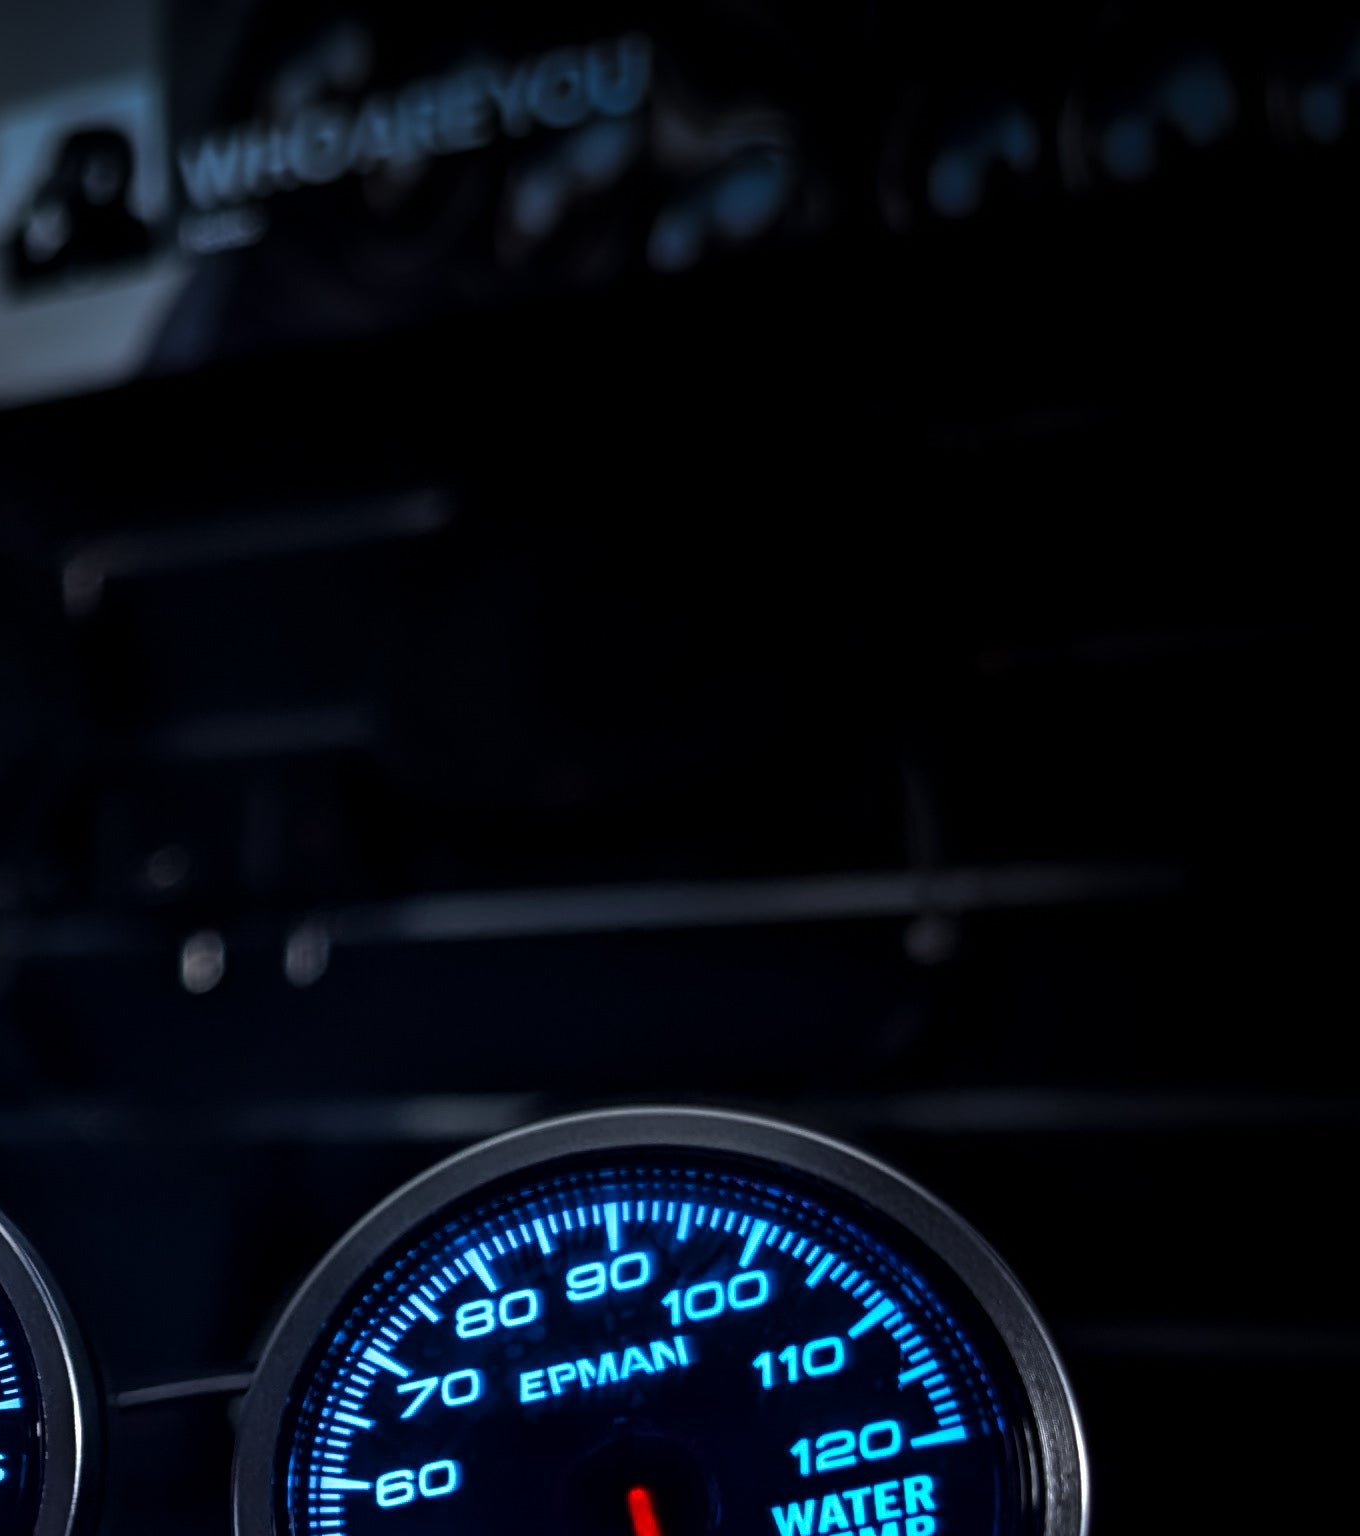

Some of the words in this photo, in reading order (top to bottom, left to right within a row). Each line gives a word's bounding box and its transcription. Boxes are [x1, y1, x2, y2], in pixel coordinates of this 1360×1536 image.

[566, 1248, 655, 1304] 90
[661, 1269, 773, 1327] 100
[455, 1284, 543, 1340] 80
[519, 1335, 693, 1404] EPMAN
[752, 1336, 847, 1390] 110
[392, 1364, 485, 1420] 70
[790, 1419, 903, 1477] 120
[375, 1459, 461, 1508] 60
